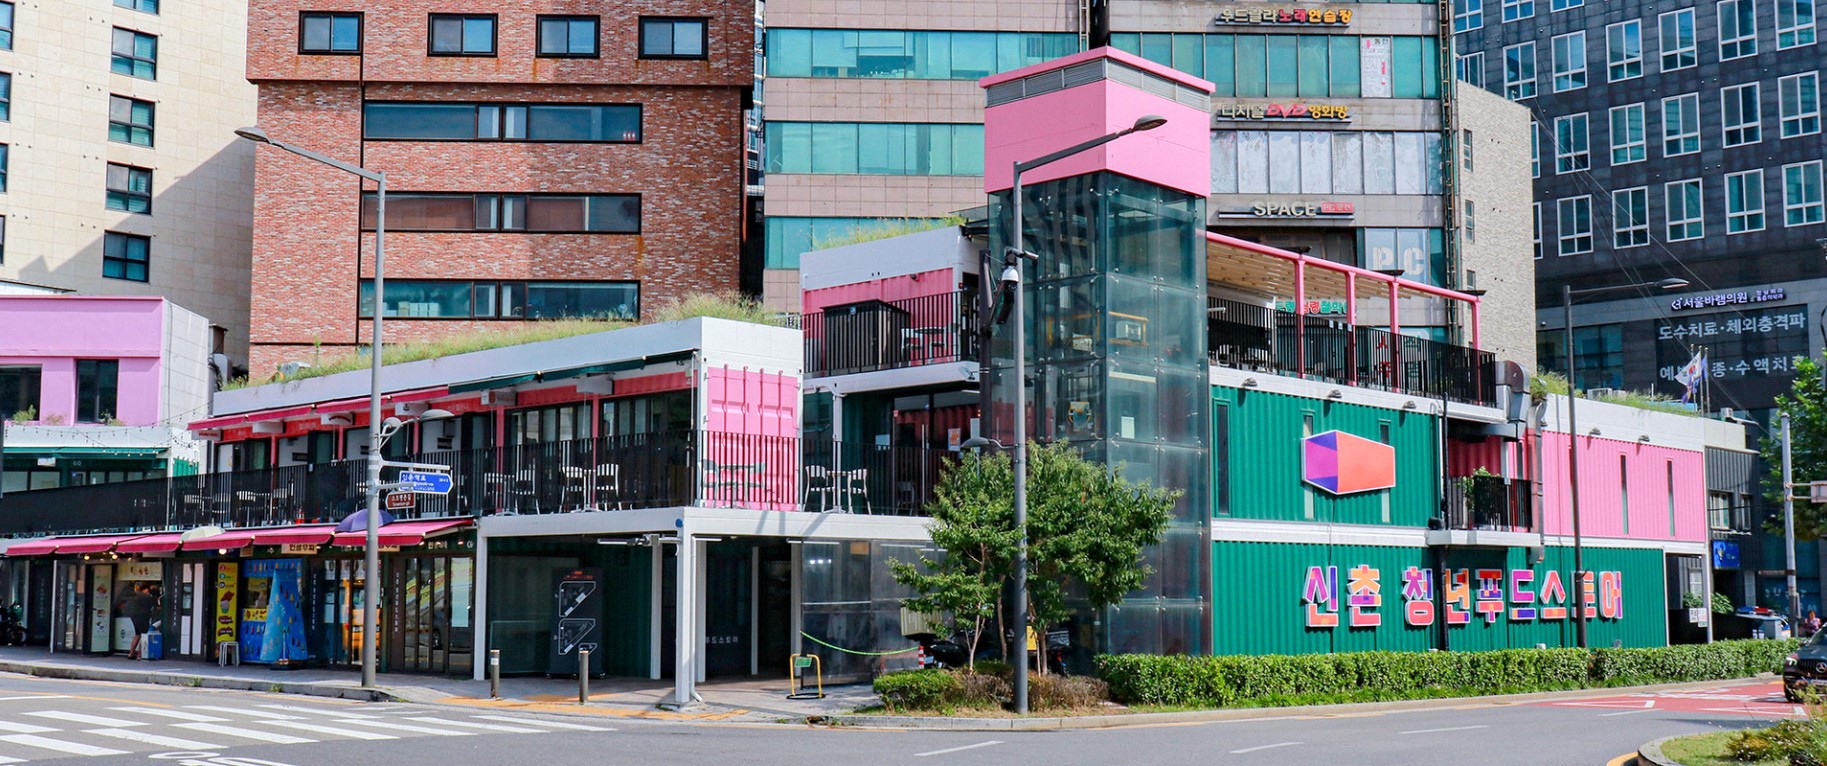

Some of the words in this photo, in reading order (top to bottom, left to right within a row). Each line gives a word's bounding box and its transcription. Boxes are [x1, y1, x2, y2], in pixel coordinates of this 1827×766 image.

[1253, 201, 1316, 217] SPACE
[1683, 291, 1748, 309] 서울바램의원
[1301, 563, 1382, 628] 신촌
[1402, 565, 1623, 626] 청년푸드스토어
